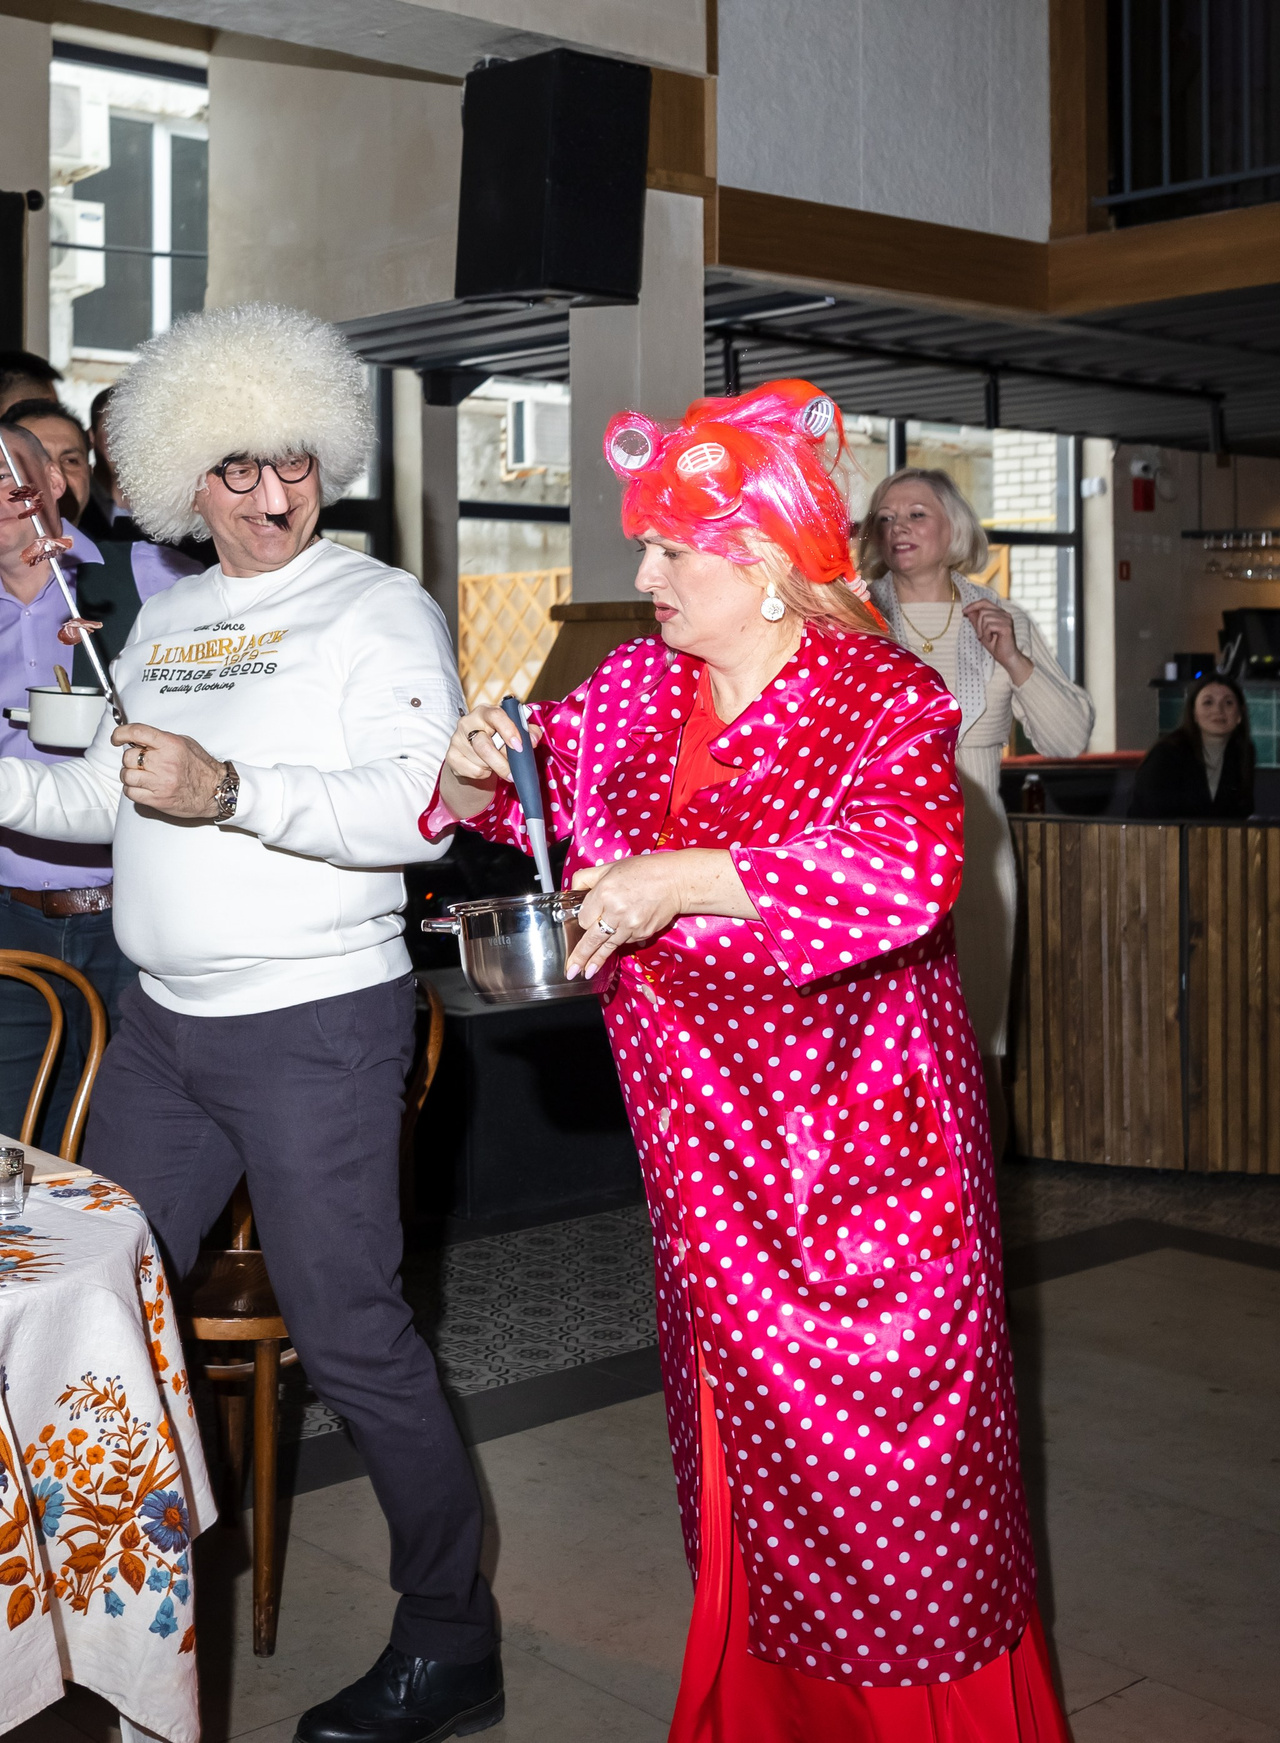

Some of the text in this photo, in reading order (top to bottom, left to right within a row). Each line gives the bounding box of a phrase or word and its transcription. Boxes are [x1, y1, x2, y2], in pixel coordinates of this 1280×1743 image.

[213, 622, 246, 631] Since
[145, 629, 289, 665] LUMBERJACK
[223, 649, 260, 667] 1979
[142, 662, 277, 682] HERITAGE GOODS
[160, 682, 235, 694] Quality Clothing
